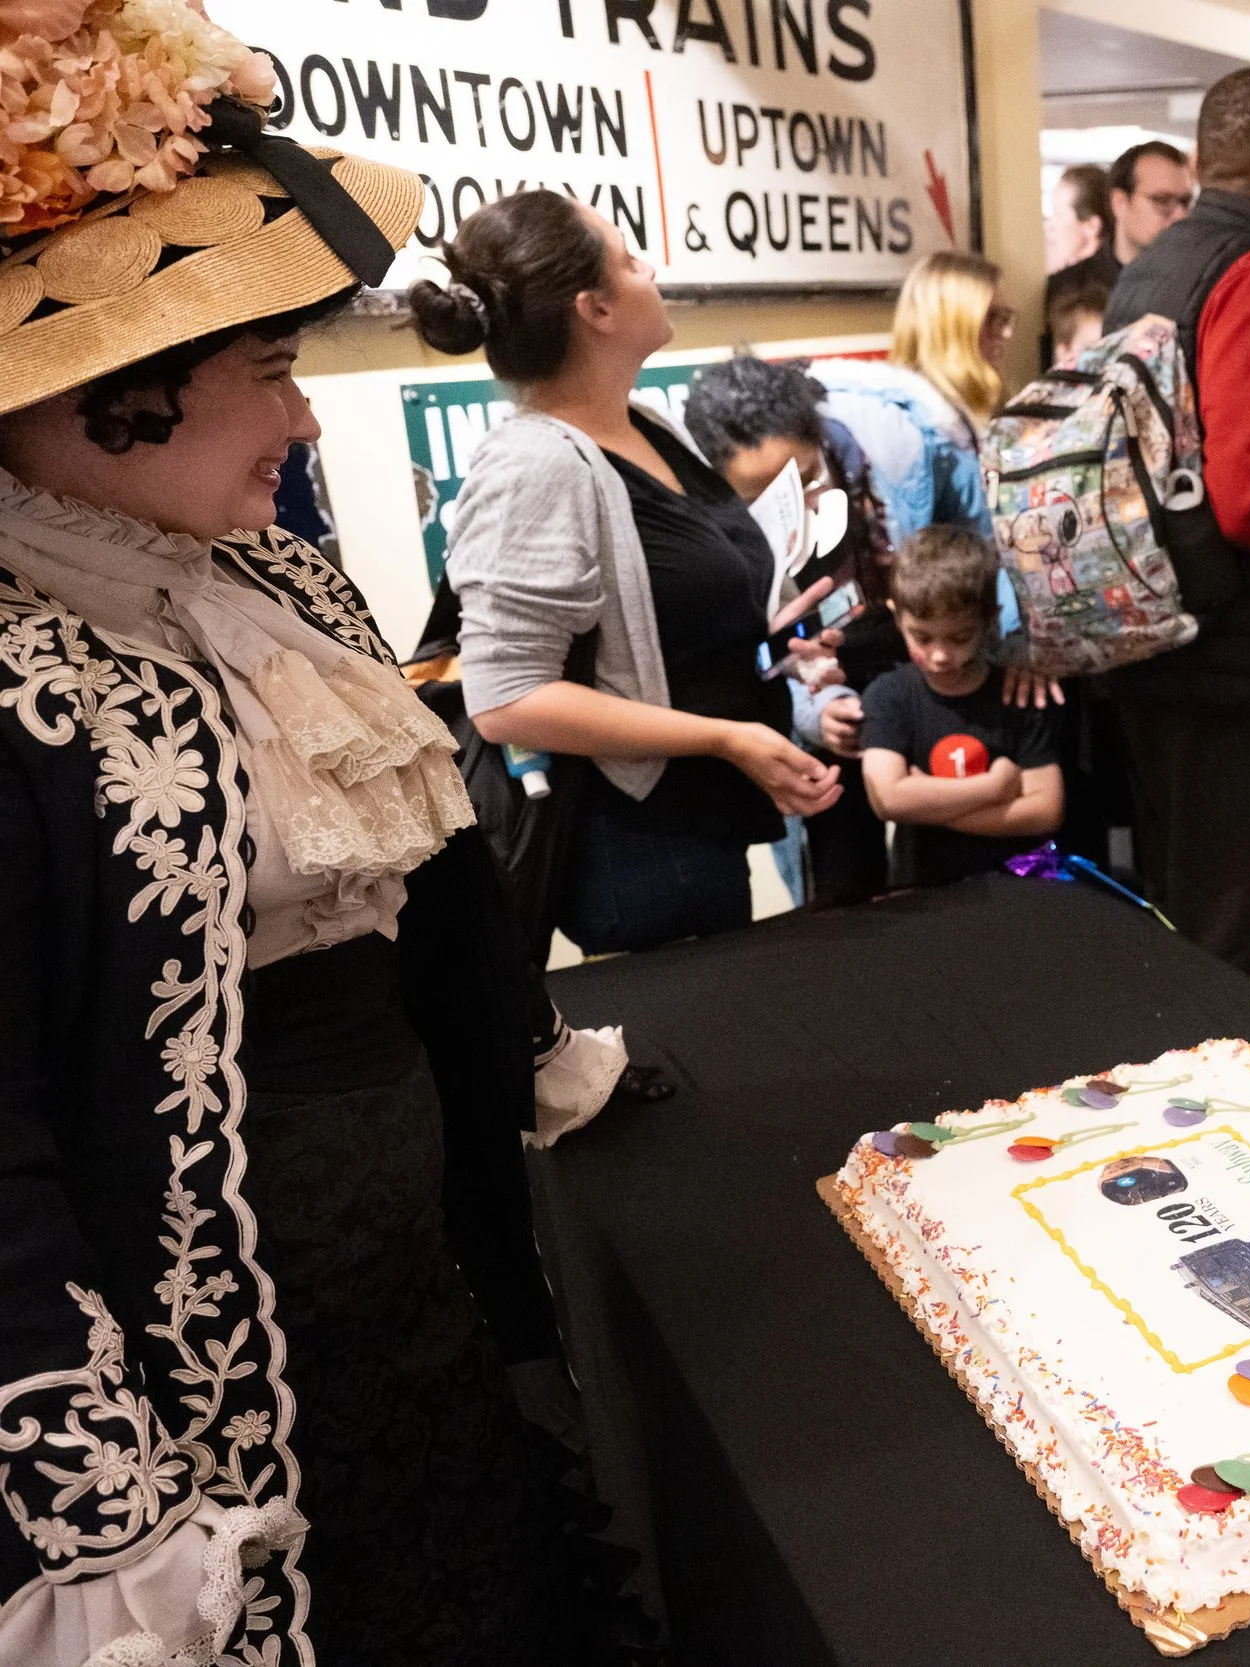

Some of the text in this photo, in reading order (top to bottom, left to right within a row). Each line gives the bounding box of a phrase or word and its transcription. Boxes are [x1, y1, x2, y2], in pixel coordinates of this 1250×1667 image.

[698, 99, 889, 178] UPTOWN
[685, 190, 914, 260] & QUEENS
[948, 747, 966, 779] 1
[1156, 1202, 1223, 1244] 120
[1195, 1196, 1236, 1232] YEARS
